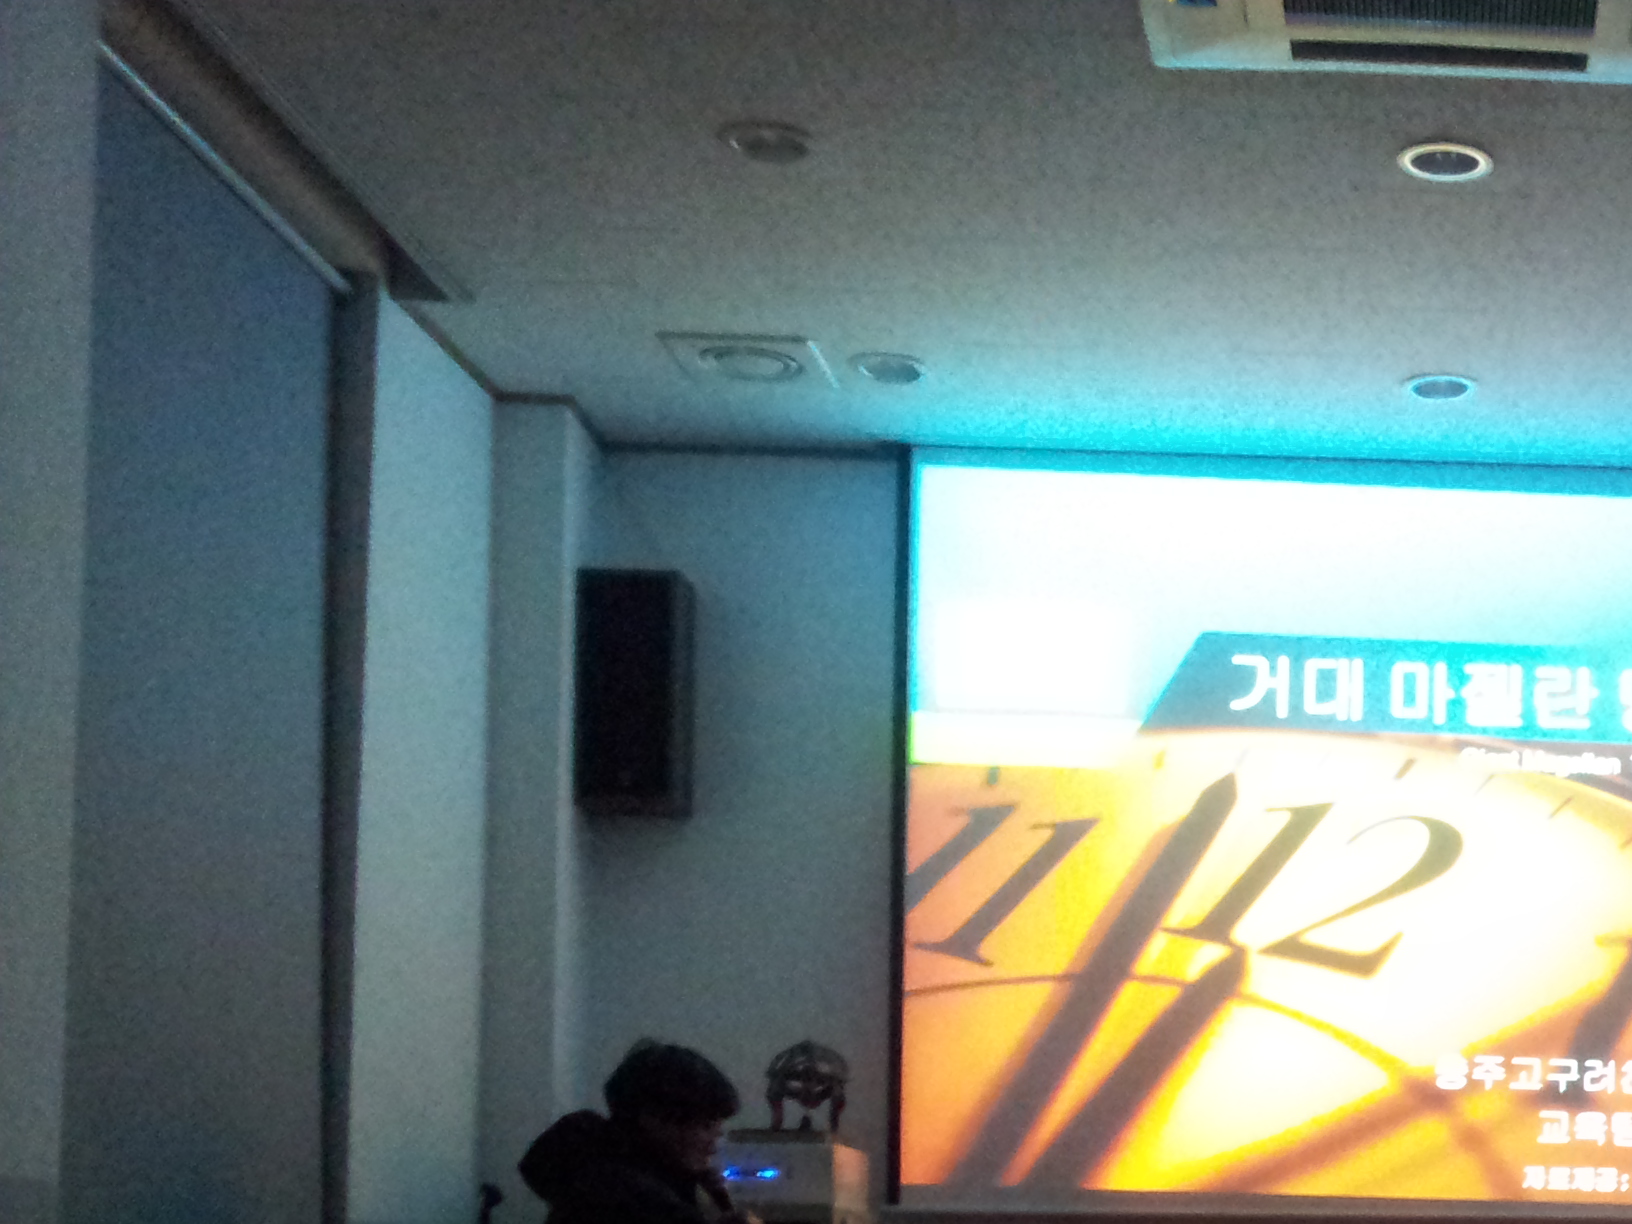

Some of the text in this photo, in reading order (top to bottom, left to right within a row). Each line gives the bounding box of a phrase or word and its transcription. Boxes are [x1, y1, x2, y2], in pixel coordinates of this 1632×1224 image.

[1229, 653, 1366, 722] 거대
[1389, 660, 1601, 731] 마젤란
[1160, 802, 1464, 978] 12
